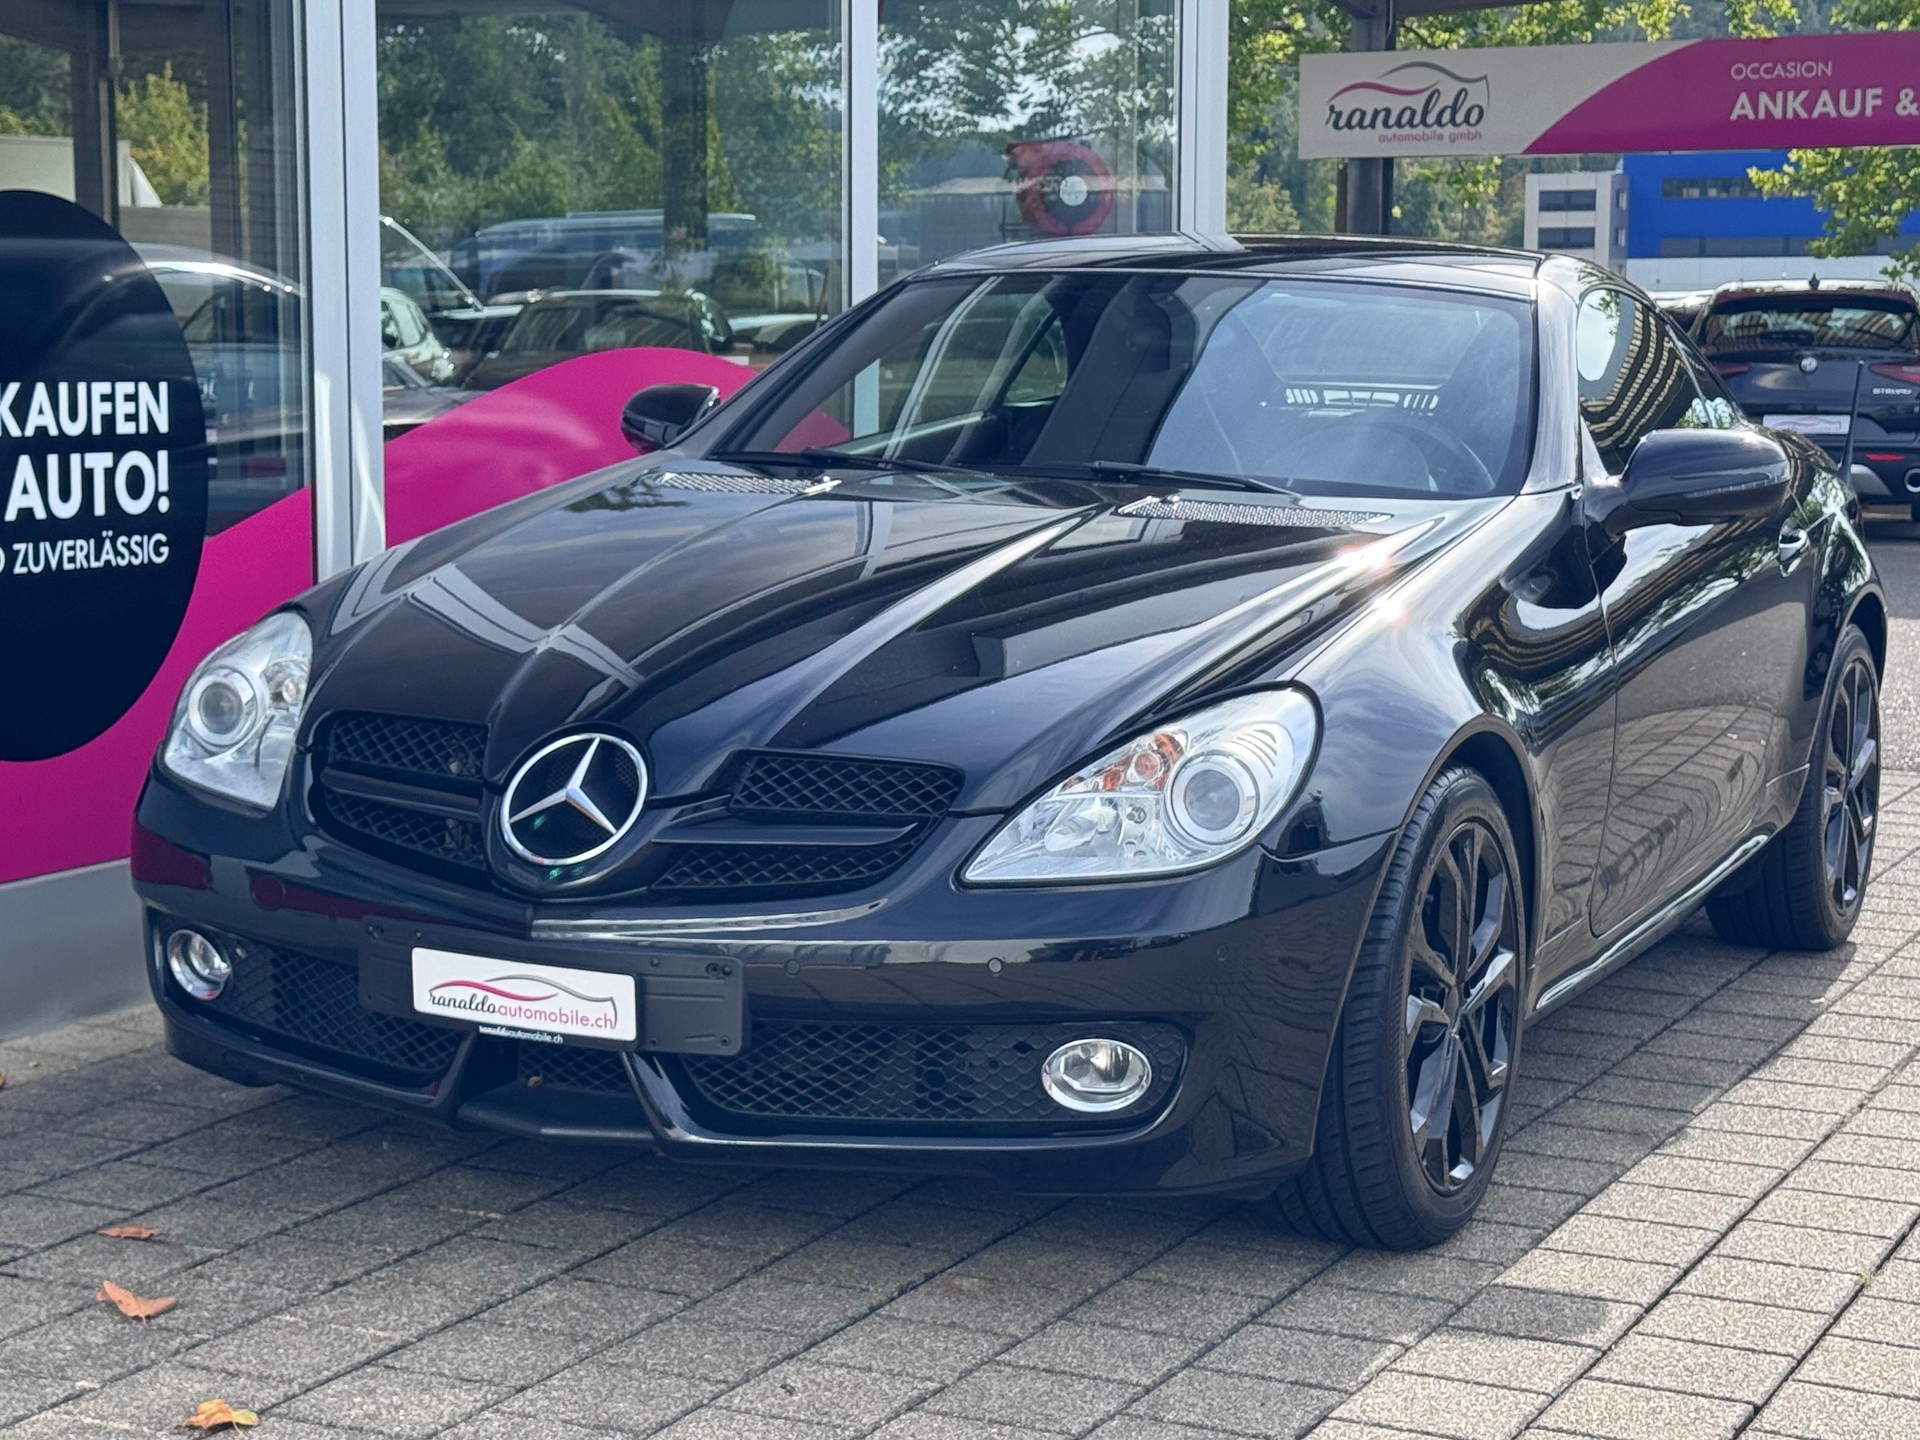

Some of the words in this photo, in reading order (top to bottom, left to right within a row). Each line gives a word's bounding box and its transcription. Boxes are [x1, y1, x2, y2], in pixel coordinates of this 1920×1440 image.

[1730, 60, 1833, 81] OCCASION
[1325, 87, 1485, 131] ranaldo
[1729, 87, 1884, 122] ANKAUF
[1895, 87, 1920, 117] &
[1378, 132, 1445, 143] automobile
[1448, 130, 1483, 144] gmbh
[0, 381, 170, 438] KAUFEN
[4, 449, 171, 522] AUTO!
[12, 530, 170, 574] ZUVERLÄSSIG
